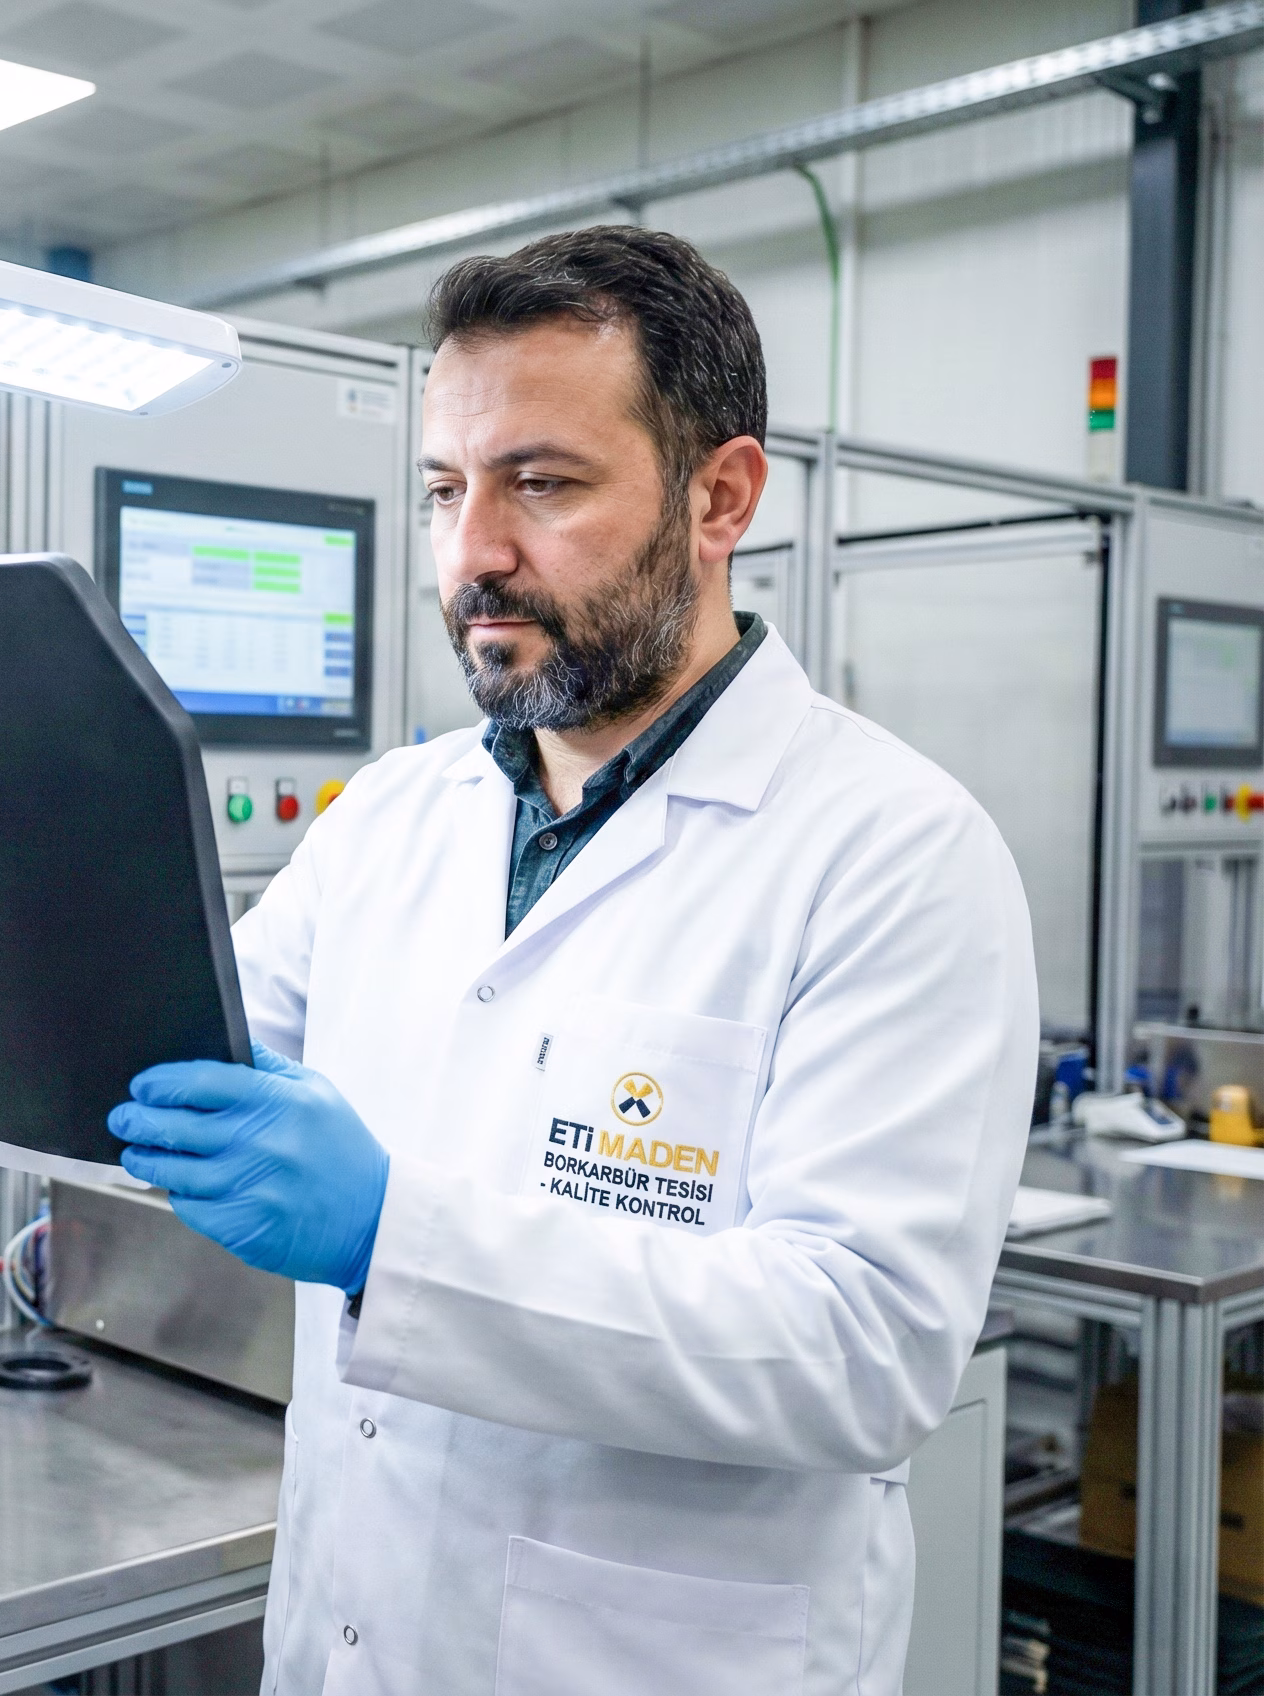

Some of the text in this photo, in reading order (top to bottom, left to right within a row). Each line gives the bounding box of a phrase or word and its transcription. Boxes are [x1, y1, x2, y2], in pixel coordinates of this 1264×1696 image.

[543, 1151, 650, 1191] BORKARBÜR
[598, 1130, 719, 1176] MADEN
[615, 1193, 705, 1225] KONTROL
